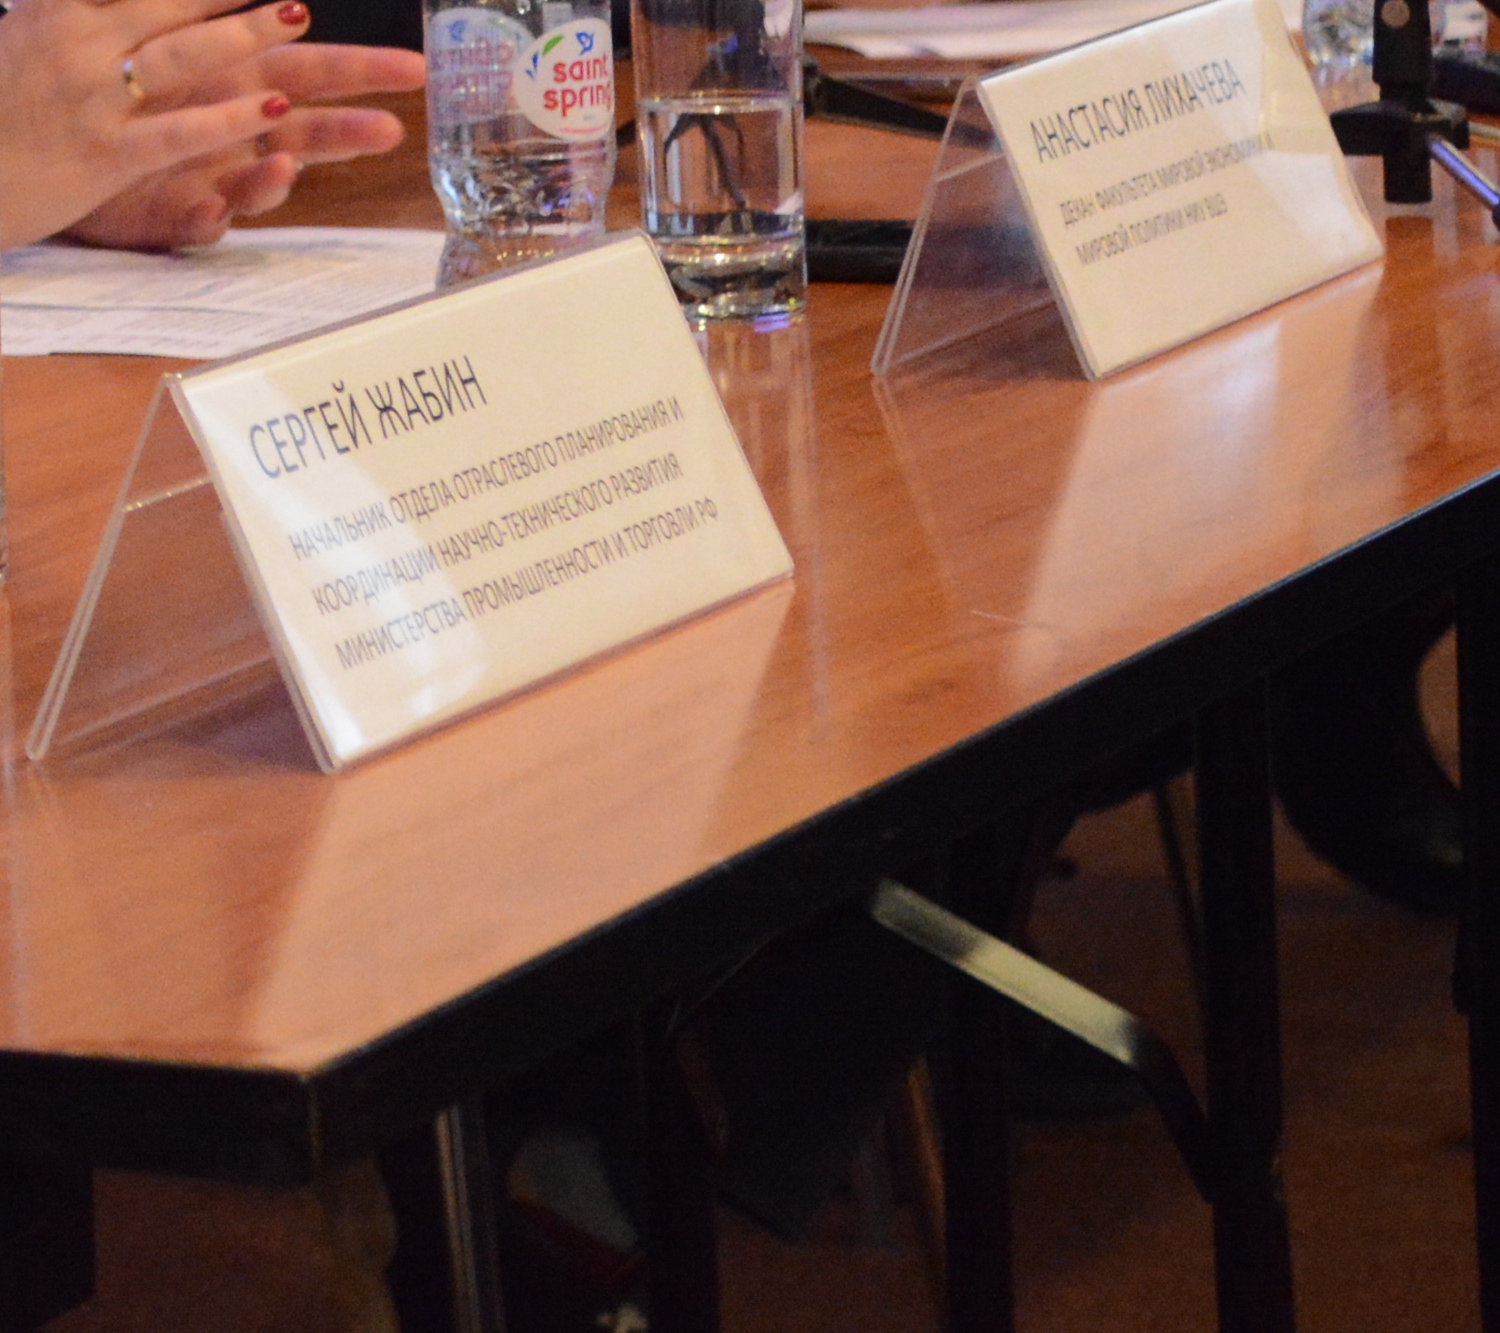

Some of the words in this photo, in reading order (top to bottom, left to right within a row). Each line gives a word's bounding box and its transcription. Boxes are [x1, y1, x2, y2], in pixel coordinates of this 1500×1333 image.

[1030, 89, 1150, 163] АНАСТАСИЯ
[1144, 59, 1247, 124] ЛИХАЧЕВА
[249, 380, 372, 479] СЕРГЕЙ
[365, 355, 487, 439] ЖАБИН
[289, 500, 392, 561] НАЧАЛЬНИК
[389, 479, 457, 524] ОТДЕЛА
[452, 441, 558, 501] ОТРАСЛЕВОГО
[555, 400, 672, 463] ПЛАНИРОВАНИЯ
[667, 395, 685, 421] И
[311, 546, 441, 617] КООРДИНАЦИИ
[439, 478, 614, 568] НАУЧНО-ТЕХНИЧЕСКОГО
[610, 452, 684, 501] РАЗВИТИЯ
[334, 597, 467, 671] МИНИСТЕРСТВА
[461, 536, 617, 619] ПРОМЫШЛЕННОСТИ
[609, 533, 630, 559] И
[623, 503, 700, 552] ТОРГОВЛИ
[694, 495, 719, 526] РФ
